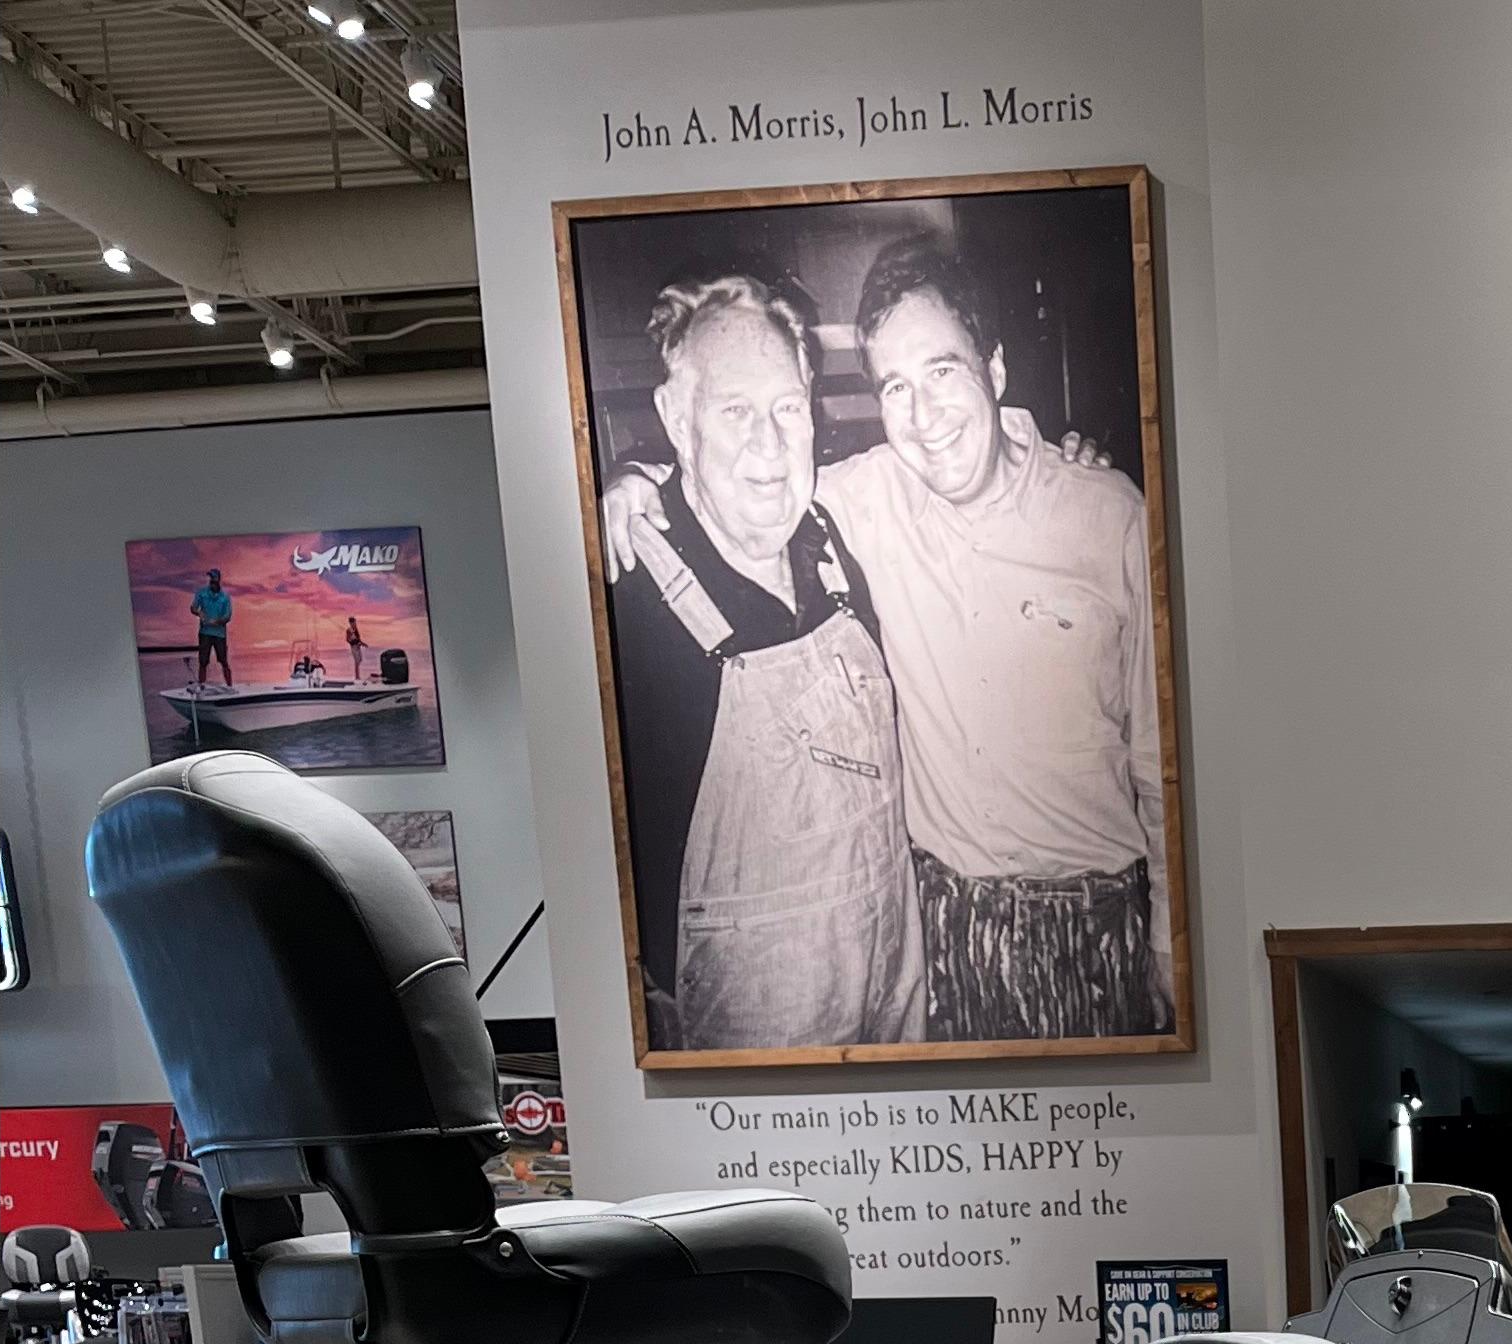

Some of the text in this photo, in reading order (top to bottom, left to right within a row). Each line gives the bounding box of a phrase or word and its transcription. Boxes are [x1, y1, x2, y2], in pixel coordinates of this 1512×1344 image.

[603, 86, 1093, 163] John A. Morris, John L. Morris
[329, 545, 399, 573] MAKO
[772, 1107, 830, 1129] main
[839, 1099, 879, 1136] job
[888, 1104, 907, 1126] is
[917, 1105, 939, 1125] to
[949, 1092, 1039, 1125] MAKE
[1050, 1091, 1136, 1132] people,
[717, 1139, 1124, 1188] and especially KIDS, HAPPY by
[858, 1195, 916, 1223] them
[927, 1201, 950, 1221] to
[960, 1200, 1032, 1220] nature
[1041, 1189, 1083, 1217] and
[1091, 1189, 1128, 1216] the
[1104, 1282, 1169, 1302] EARN UP TO
[1177, 1312, 1220, 1331] IN CLUB
